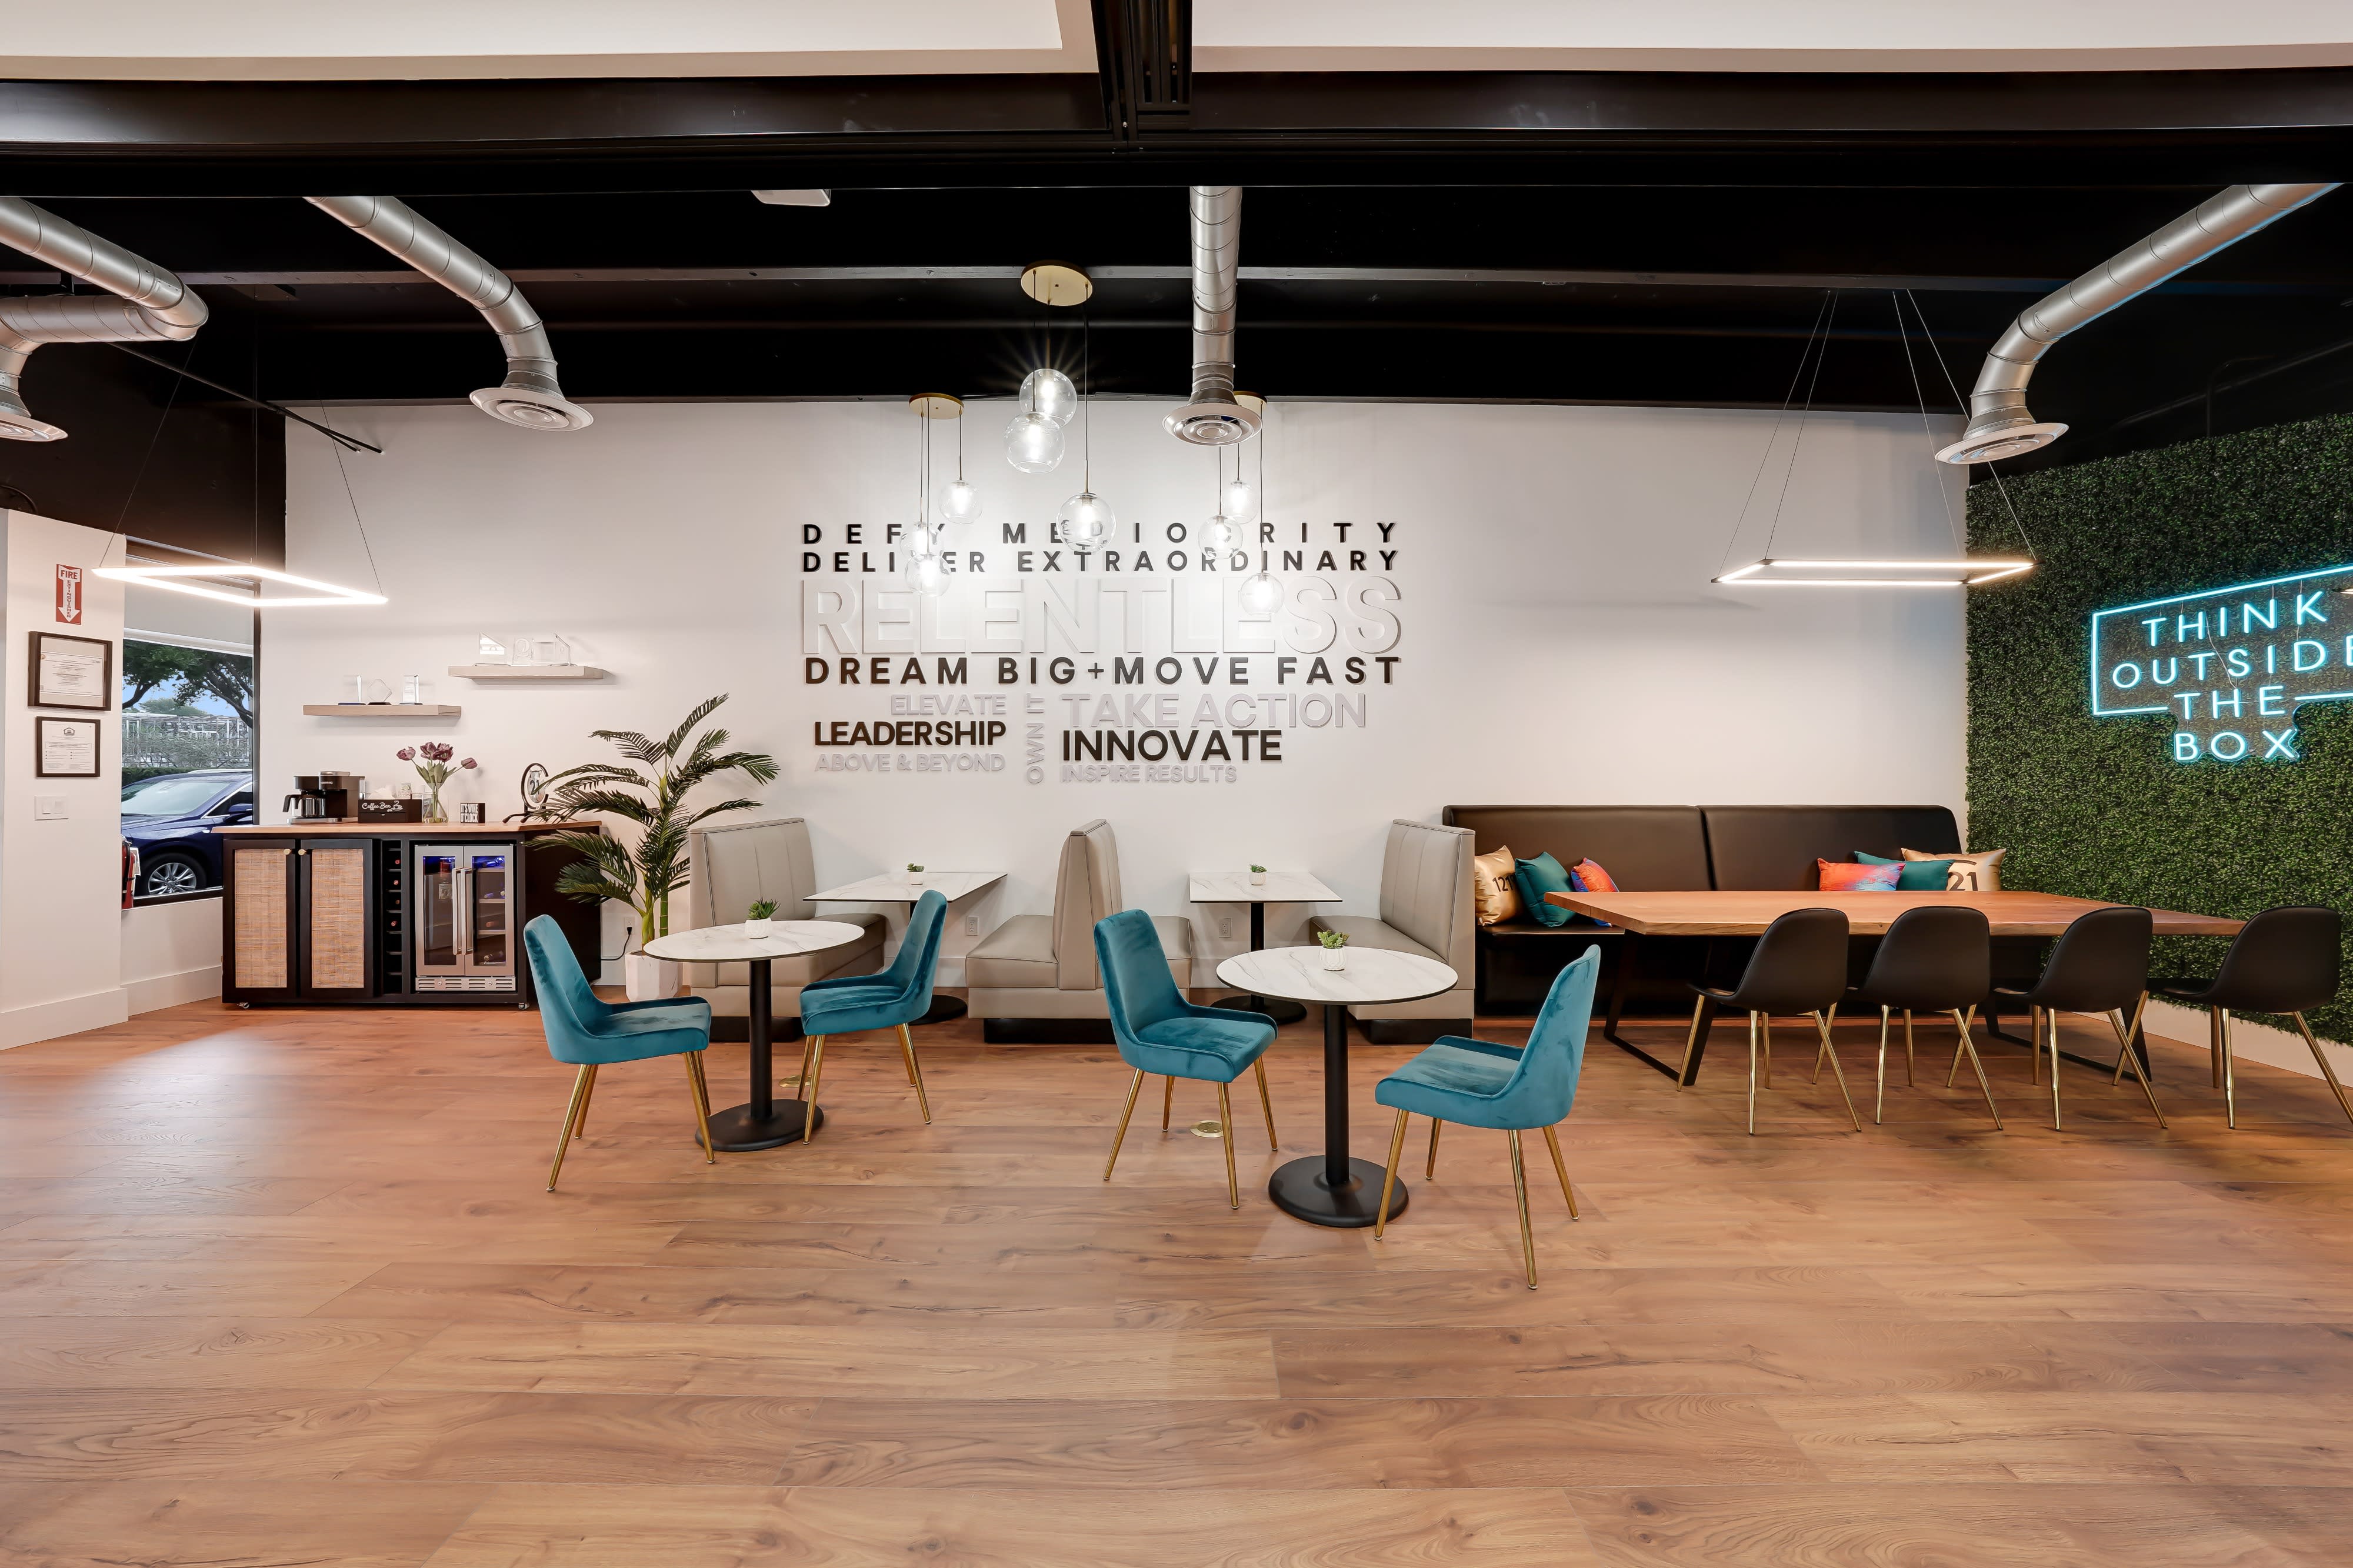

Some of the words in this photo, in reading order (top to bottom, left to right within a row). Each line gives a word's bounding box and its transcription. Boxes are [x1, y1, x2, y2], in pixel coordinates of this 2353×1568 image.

[802, 552, 985, 572] DELIER
[1018, 550, 1398, 572] EXTRAORDINARY
[61, 570, 78, 580] FIRE
[802, 575, 1402, 654] RELENTLESS
[2141, 590, 2328, 647] THINK
[805, 656, 968, 685] DREAM
[1277, 656, 1402, 685] FAST
[891, 693, 1007, 715] ELEVATE
[1025, 692, 1045, 714] IT
[1061, 693, 1179, 728] TAKE
[1189, 692, 1367, 729] ACTION
[2174, 685, 2287, 720] THE
[814, 720, 1007, 746] LEADERSHIP
[1025, 722, 1045, 785] OWN
[1062, 729, 1283, 762] INNOVATE
[2174, 730, 2298, 761] BOX
[814, 753, 891, 772] ABOVE
[896, 753, 913, 772] &
[916, 753, 1007, 772] BEYOND
[1062, 765, 1141, 783] INSPIRE
[1146, 765, 1238, 783] RESULTS
[362, 802, 379, 811] Coffee
[468, 803, 479, 813] WINE
[1948, 871, 1978, 891] 21
